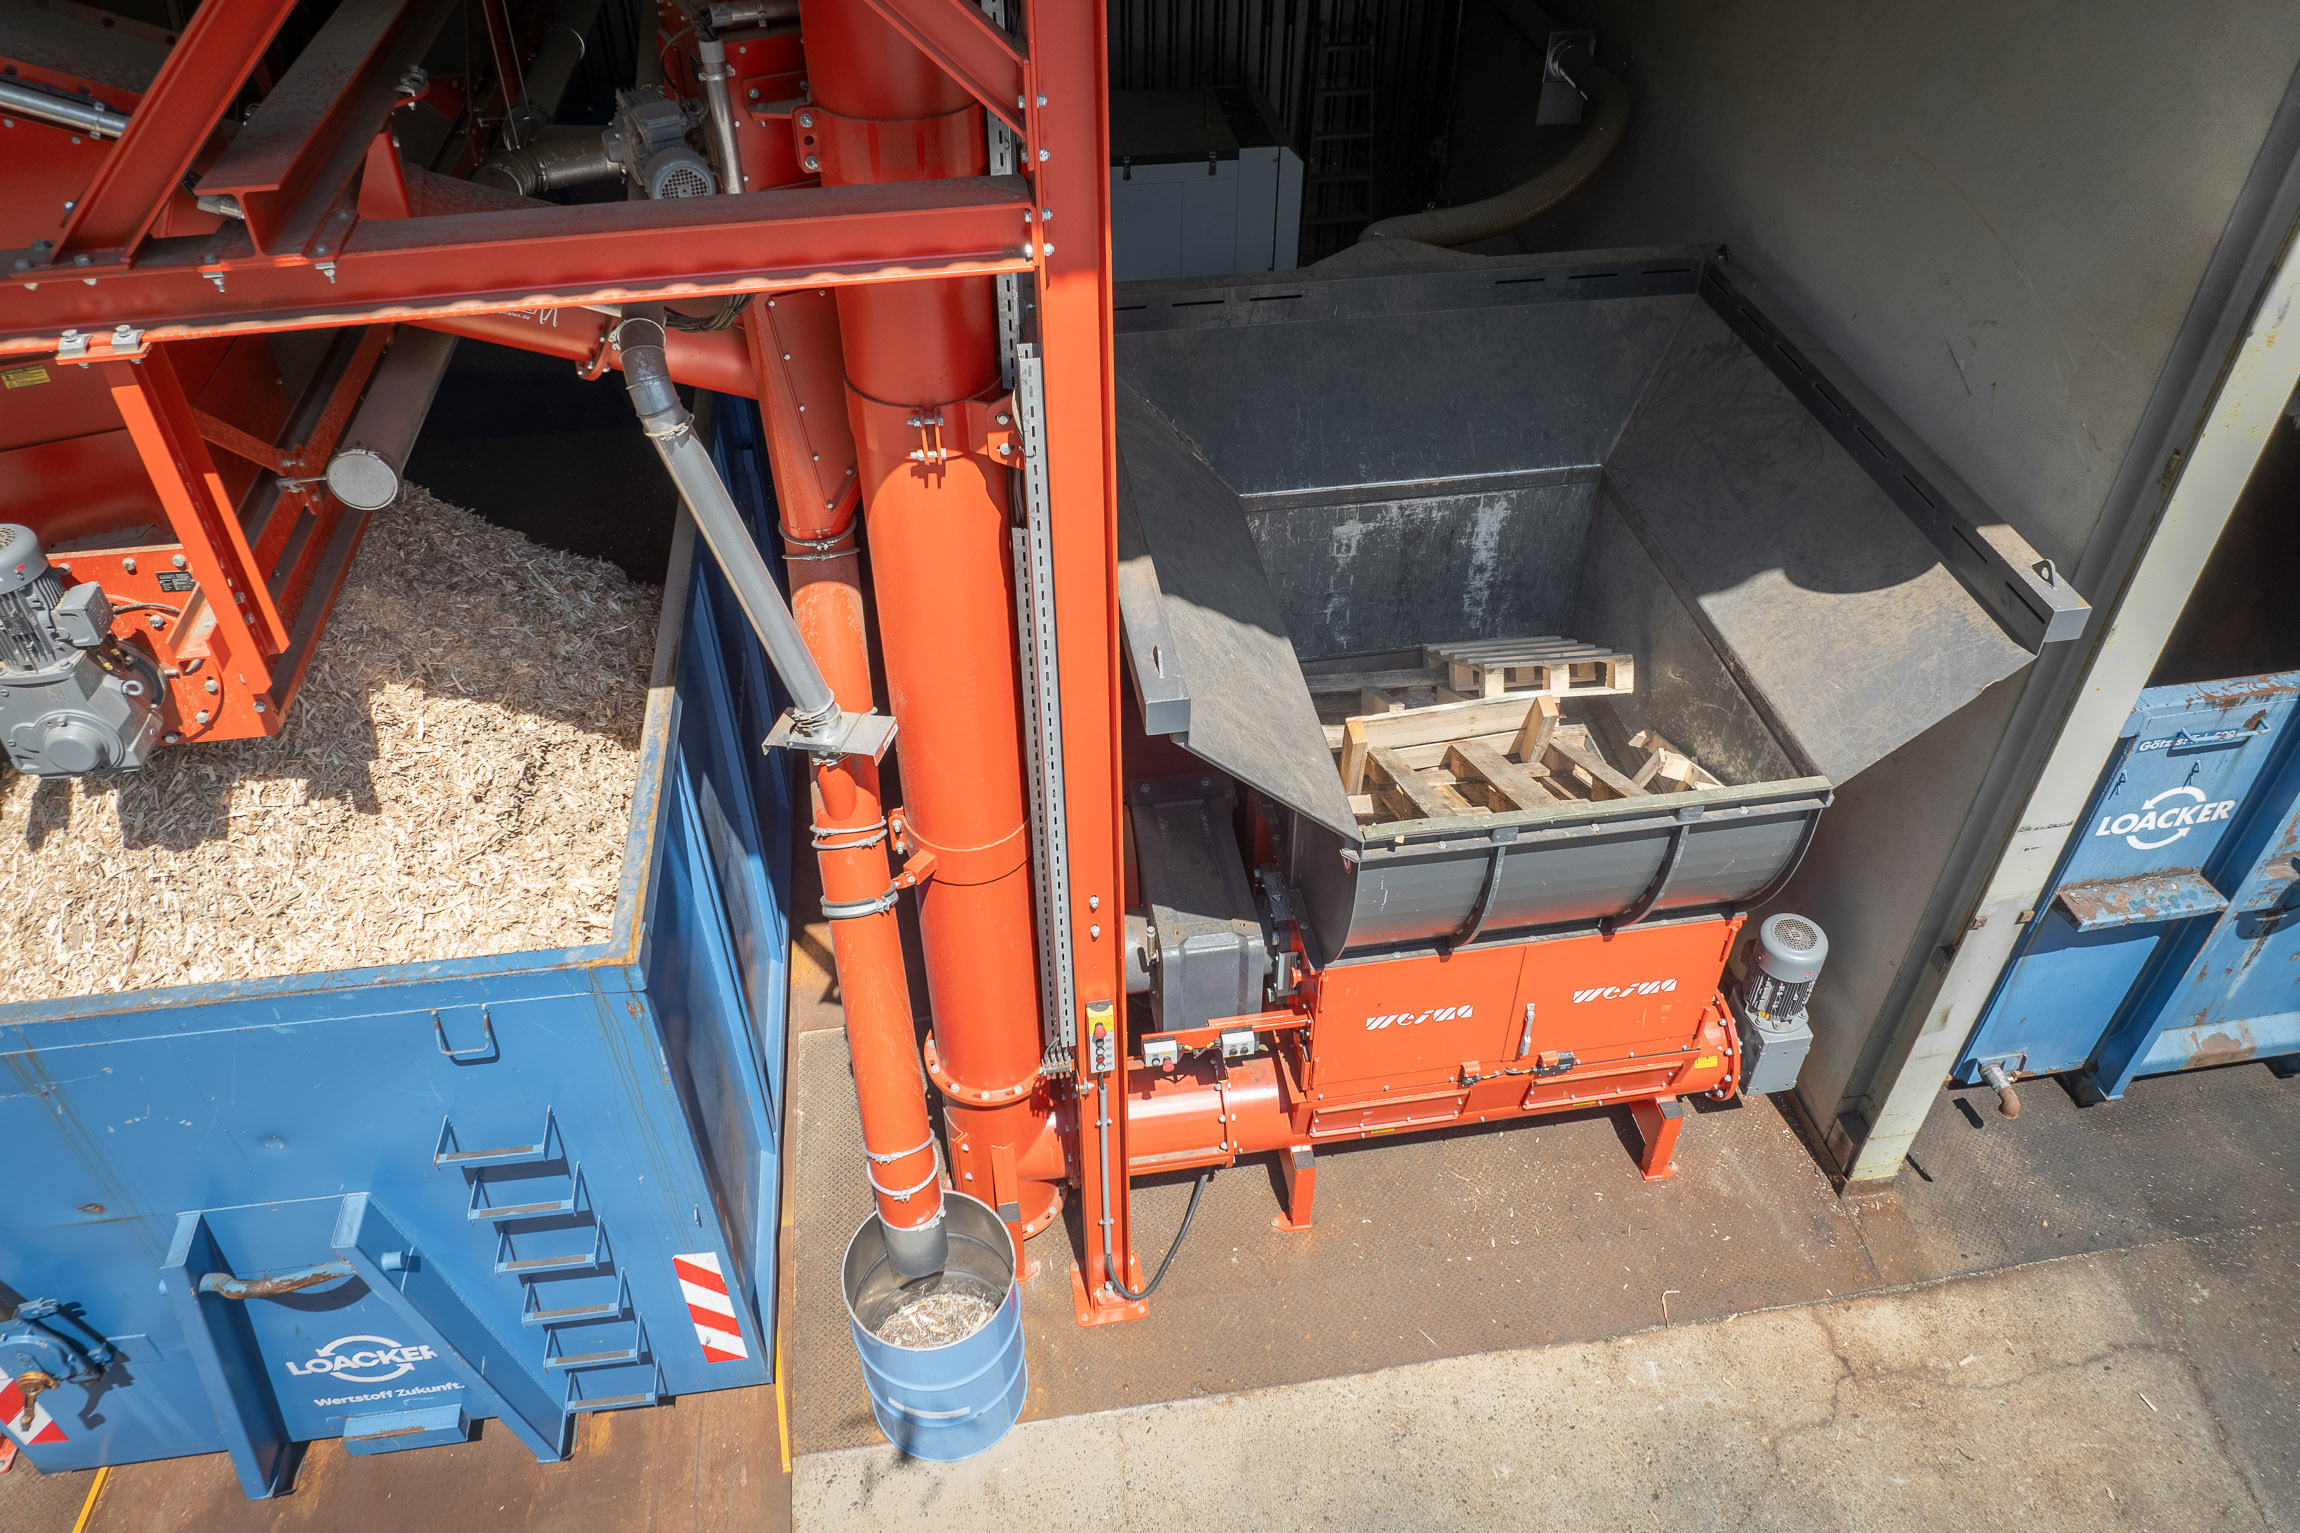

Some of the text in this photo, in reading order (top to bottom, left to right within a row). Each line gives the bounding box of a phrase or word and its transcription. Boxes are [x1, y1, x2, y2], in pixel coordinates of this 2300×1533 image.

[2095, 800, 2236, 836] LOACKER
[314, 1382, 465, 1407] Wertstoff Zukunft.
